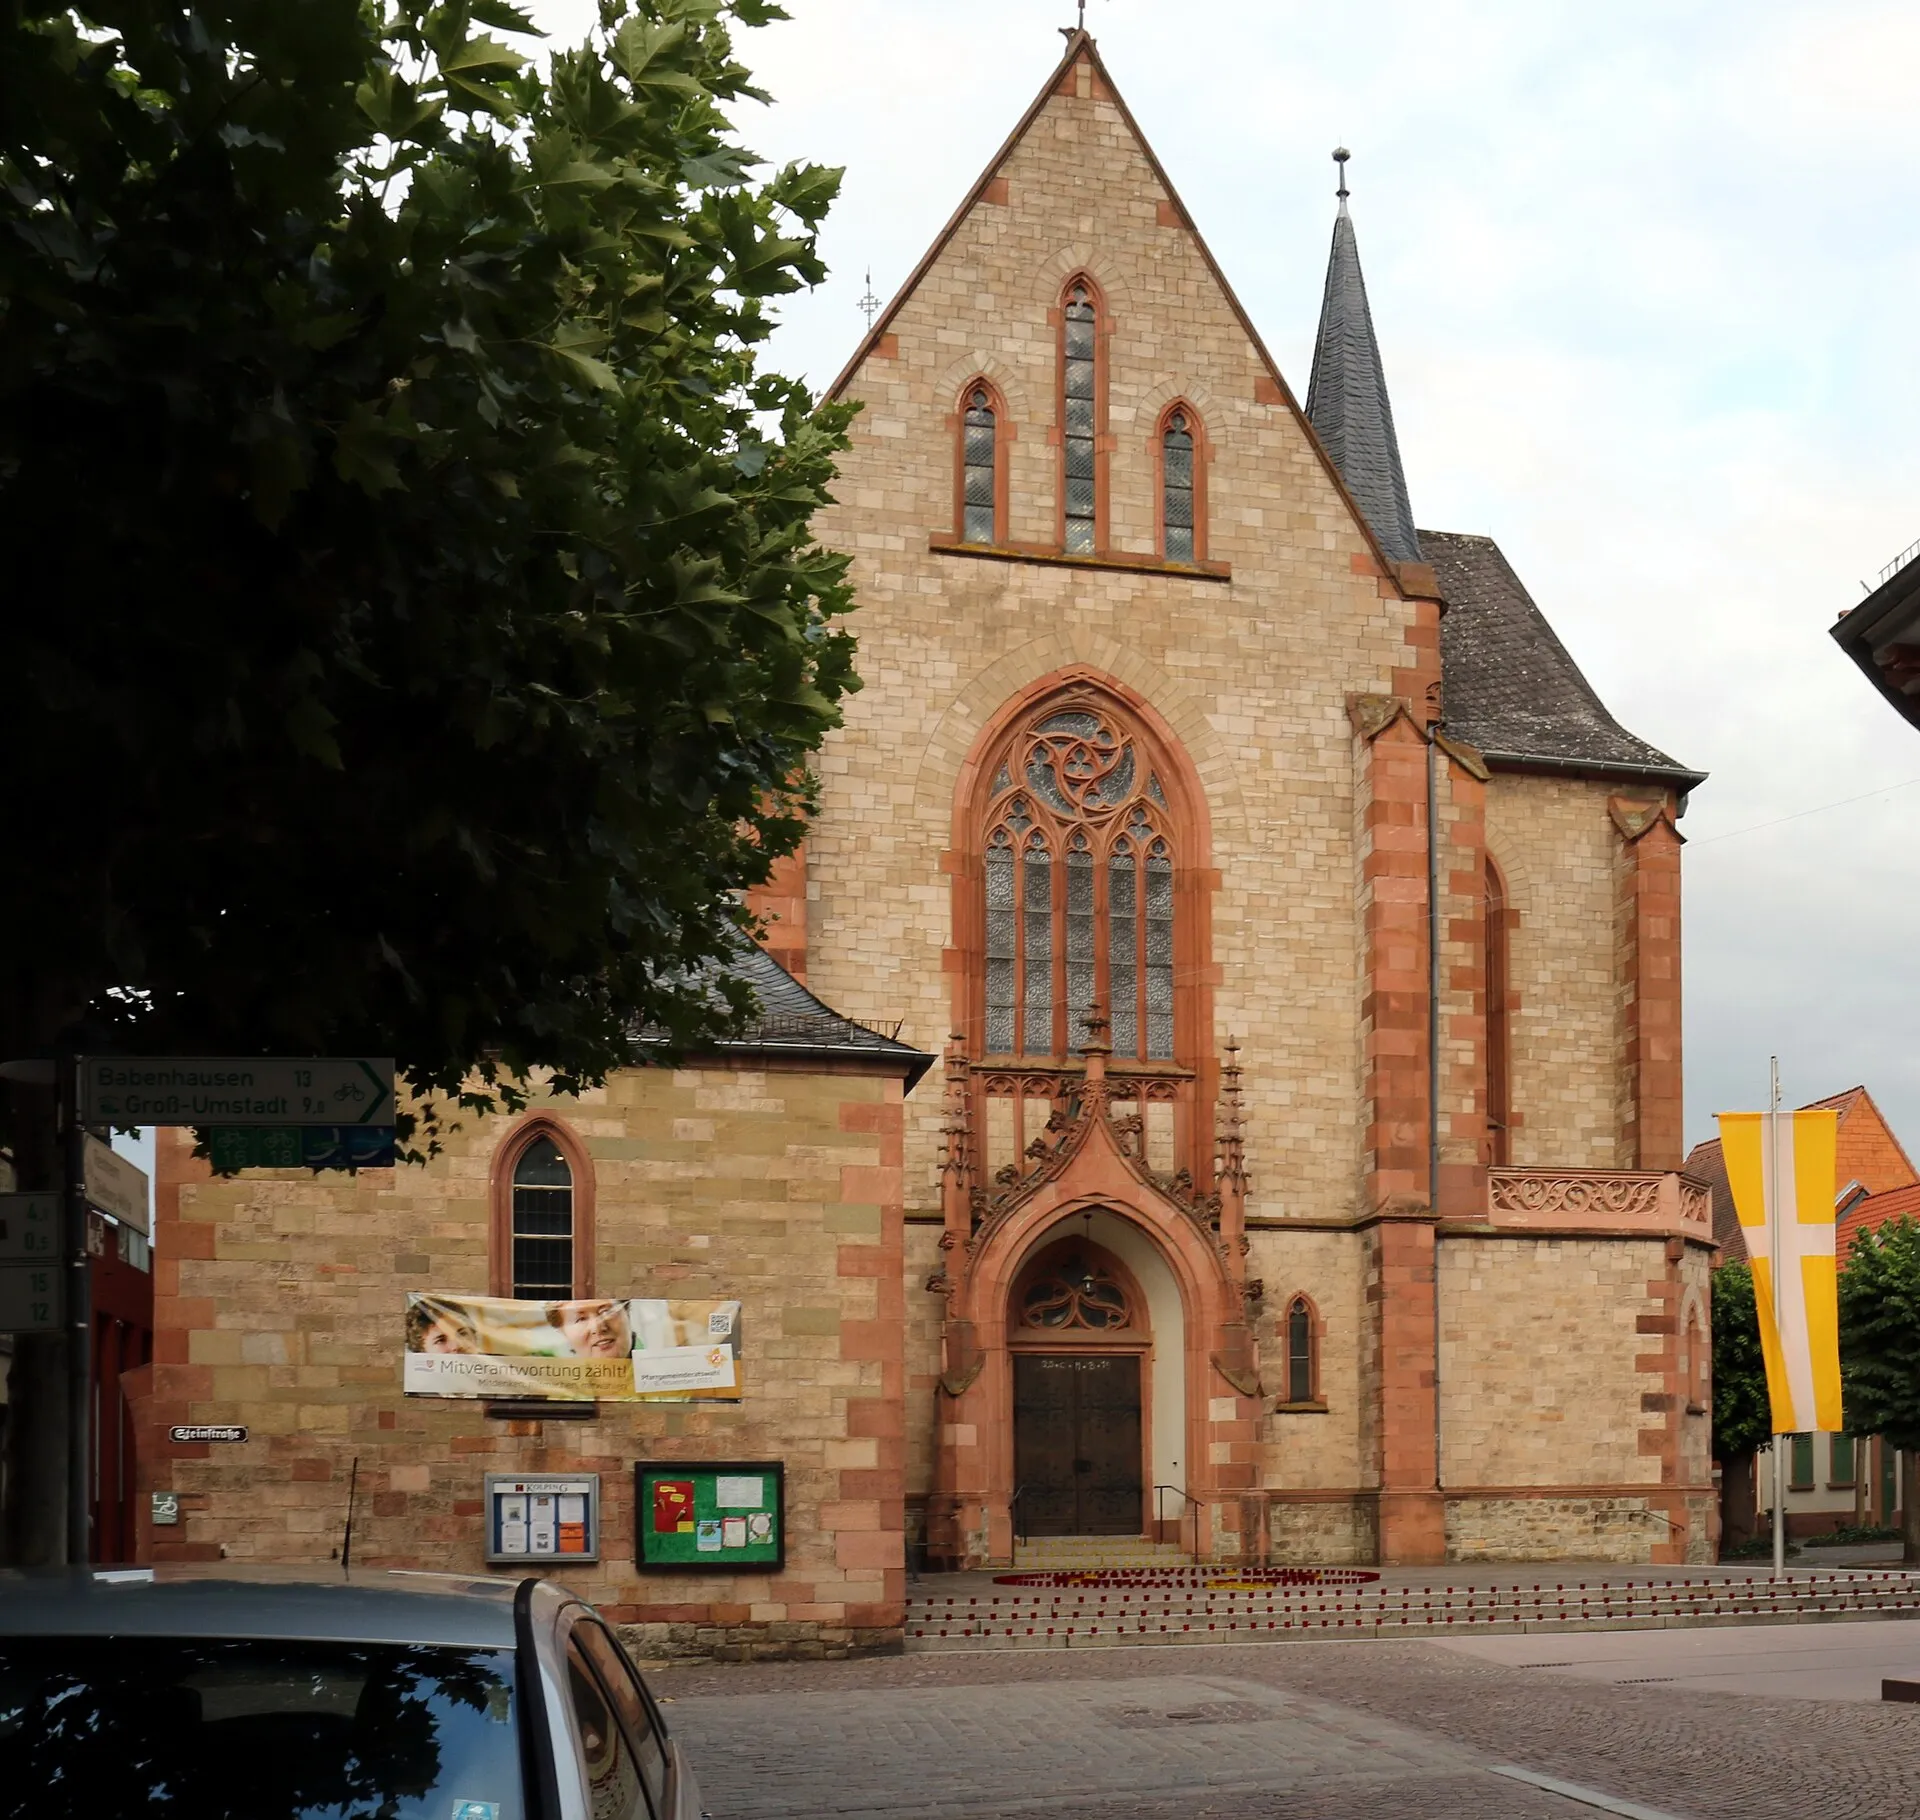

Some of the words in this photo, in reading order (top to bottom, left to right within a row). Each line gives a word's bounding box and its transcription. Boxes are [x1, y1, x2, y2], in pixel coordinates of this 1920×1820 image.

[97, 1067, 254, 1087] Babenhausen
[294, 1070, 312, 1088] 13
[125, 1095, 288, 1114] Groß-Umstadt
[223, 1150, 247, 1165] 16
[269, 1150, 293, 1165] 18
[29, 1273, 49, 1292] 15
[29, 1302, 49, 1321] 12
[440, 1360, 582, 1381] Mitverantwortung
[585, 1363, 628, 1378] zählt!
[526, 1484, 568, 1493] KOLPING
